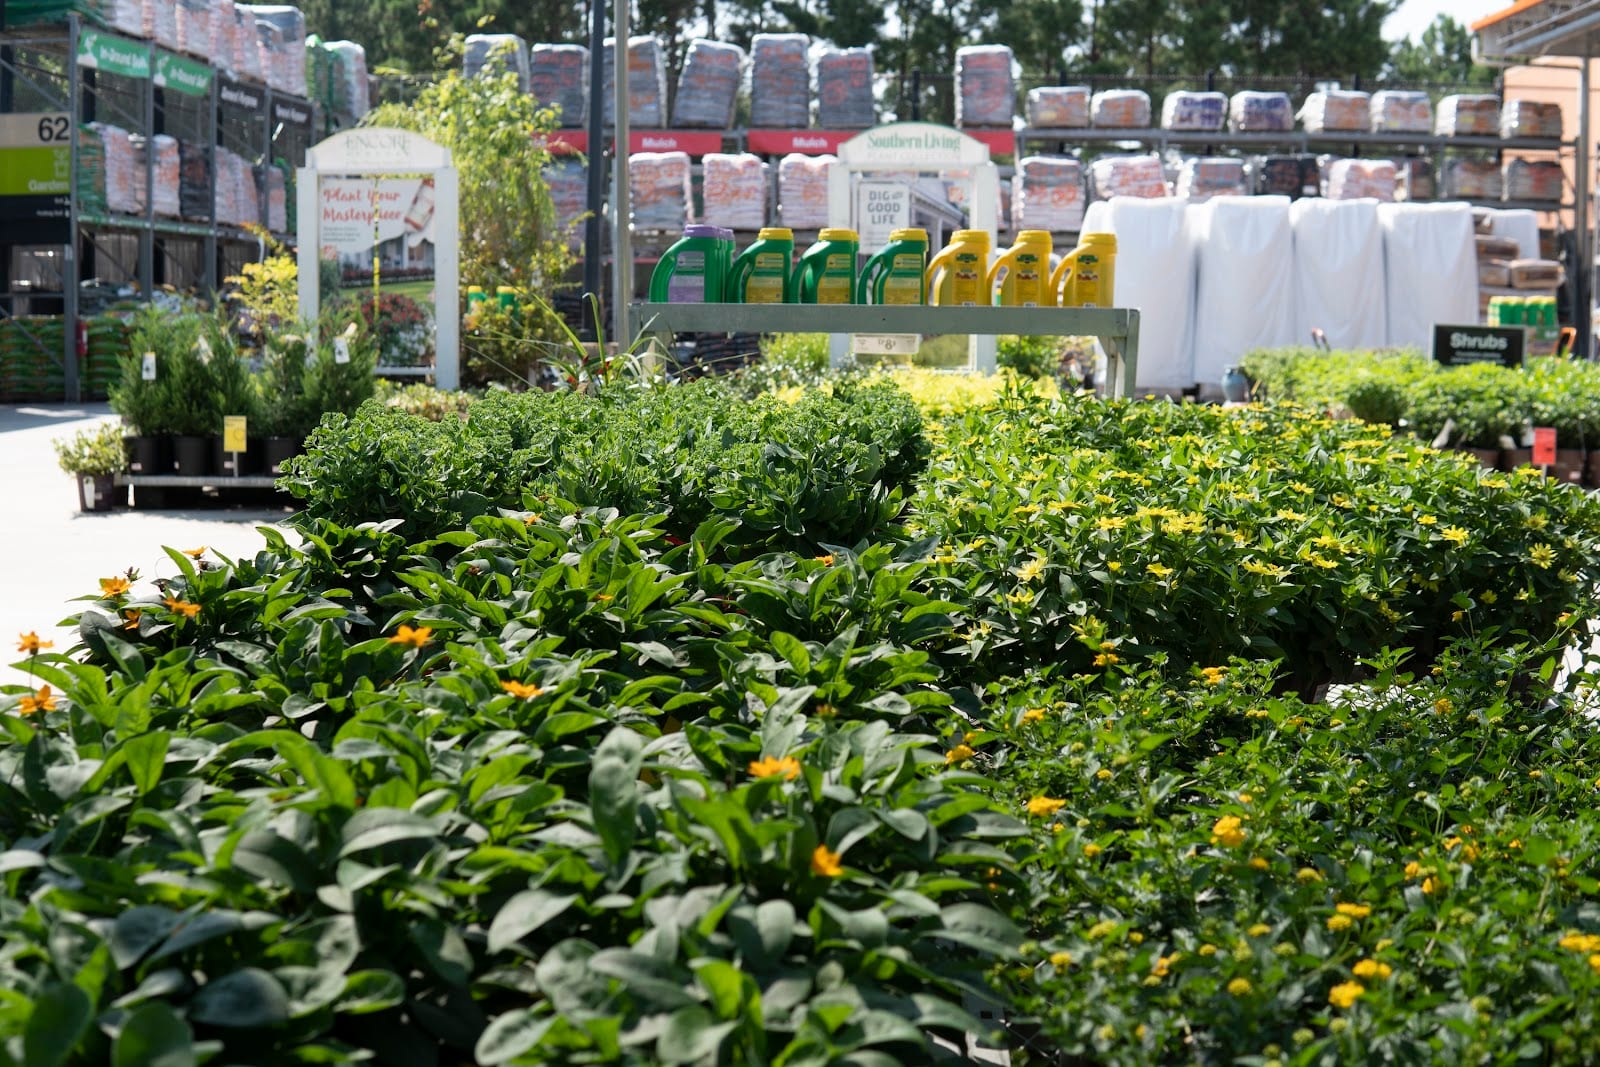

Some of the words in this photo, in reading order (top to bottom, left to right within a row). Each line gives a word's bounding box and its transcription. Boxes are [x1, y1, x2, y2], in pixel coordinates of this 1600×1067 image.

[38, 116, 70, 142] 62
[346, 134, 411, 155] ENCORE
[642, 137, 677, 149] Mulch
[792, 137, 827, 149] Mulch
[867, 133, 921, 149] Southern
[924, 132, 961, 151] Living
[28, 179, 69, 192] Garden
[322, 188, 361, 202] Plant
[367, 188, 401, 207] Your
[322, 207, 402, 226] Masterpiece
[867, 202, 901, 213] GOOD
[871, 214, 896, 225] LIFE
[1449, 332, 1508, 350] Shrubs
